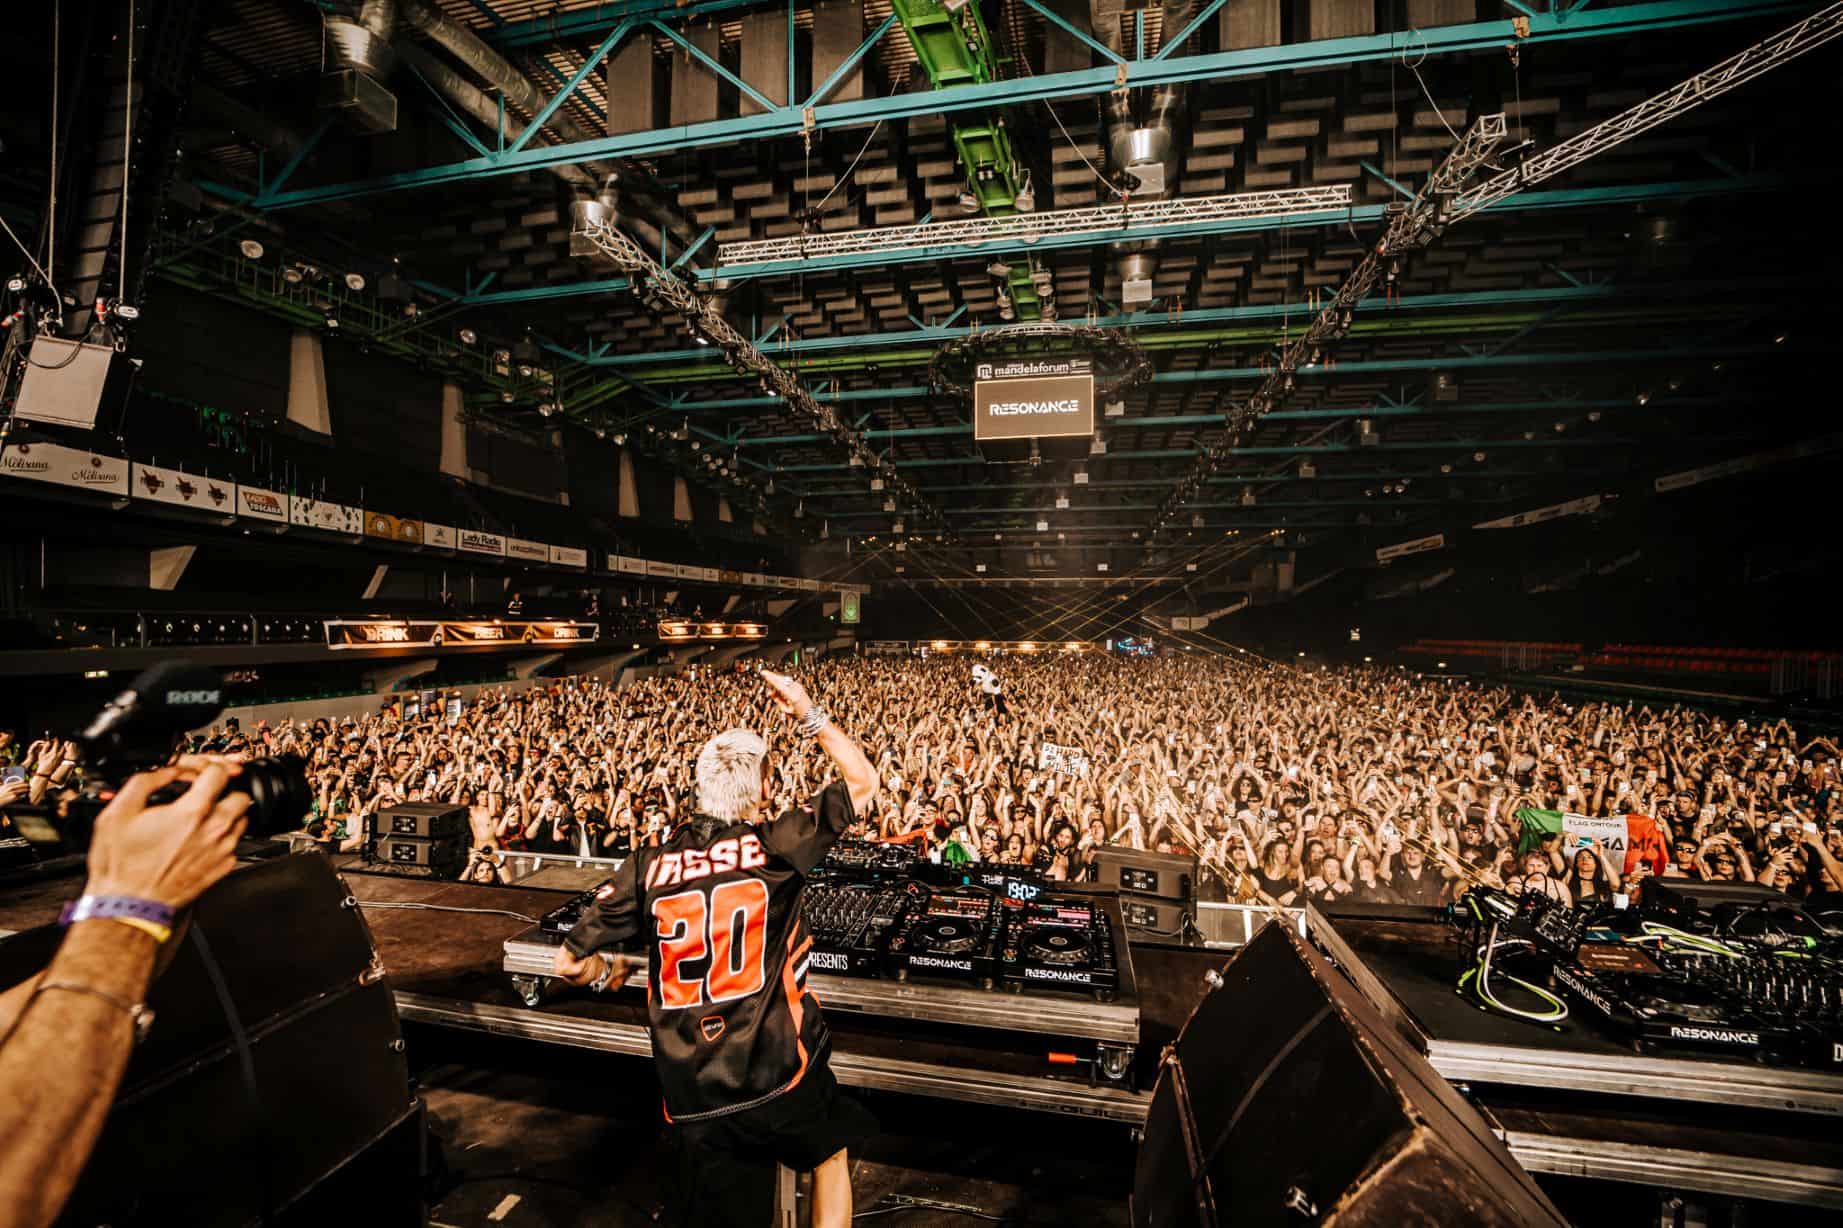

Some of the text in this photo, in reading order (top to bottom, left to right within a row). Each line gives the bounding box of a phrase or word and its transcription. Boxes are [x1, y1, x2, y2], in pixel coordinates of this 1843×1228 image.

[995, 361, 1069, 375] mandelaforum
[989, 400, 1079, 416] RESONANCE
[652, 878, 769, 1010] 20
[909, 956, 972, 970] RESONANCE
[1025, 968, 1091, 983] RESONANCE
[1553, 964, 1611, 1015] RESONANCE
[1671, 1026, 1759, 1044] RESONANCE
